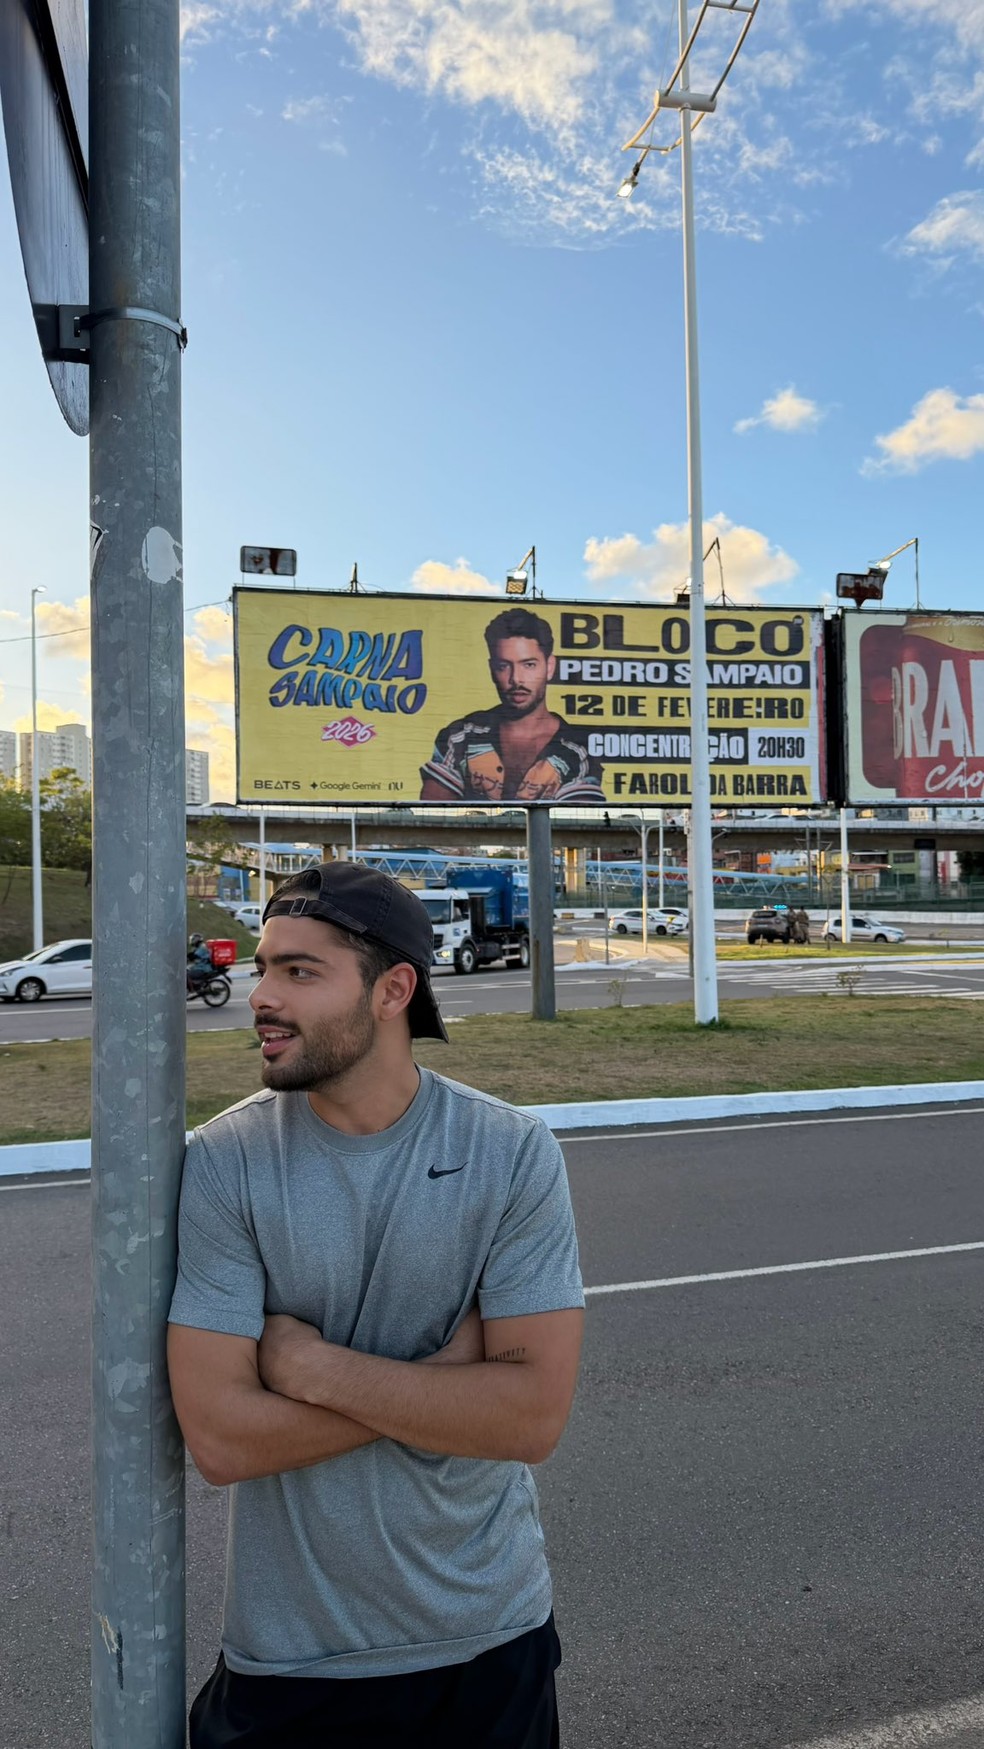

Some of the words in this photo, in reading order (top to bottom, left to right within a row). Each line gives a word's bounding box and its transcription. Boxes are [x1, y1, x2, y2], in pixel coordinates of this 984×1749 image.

[560, 613, 804, 656] BLOCO
[560, 660, 668, 684] PEDRO
[269, 670, 427, 714] SAMPAIO
[561, 694, 604, 716] 12
[612, 695, 647, 717] DE
[321, 720, 375, 743] 2026
[588, 732, 744, 762] CONCENTRÇÃO
[758, 736, 805, 758] 20H30
[254, 780, 301, 790] BEATS
[320, 781, 351, 791] Google
[352, 782, 381, 791] Gemini
[614, 773, 692, 795] FAROL
[733, 774, 808, 796] BARRA
[925, 762, 984, 797] Cho
